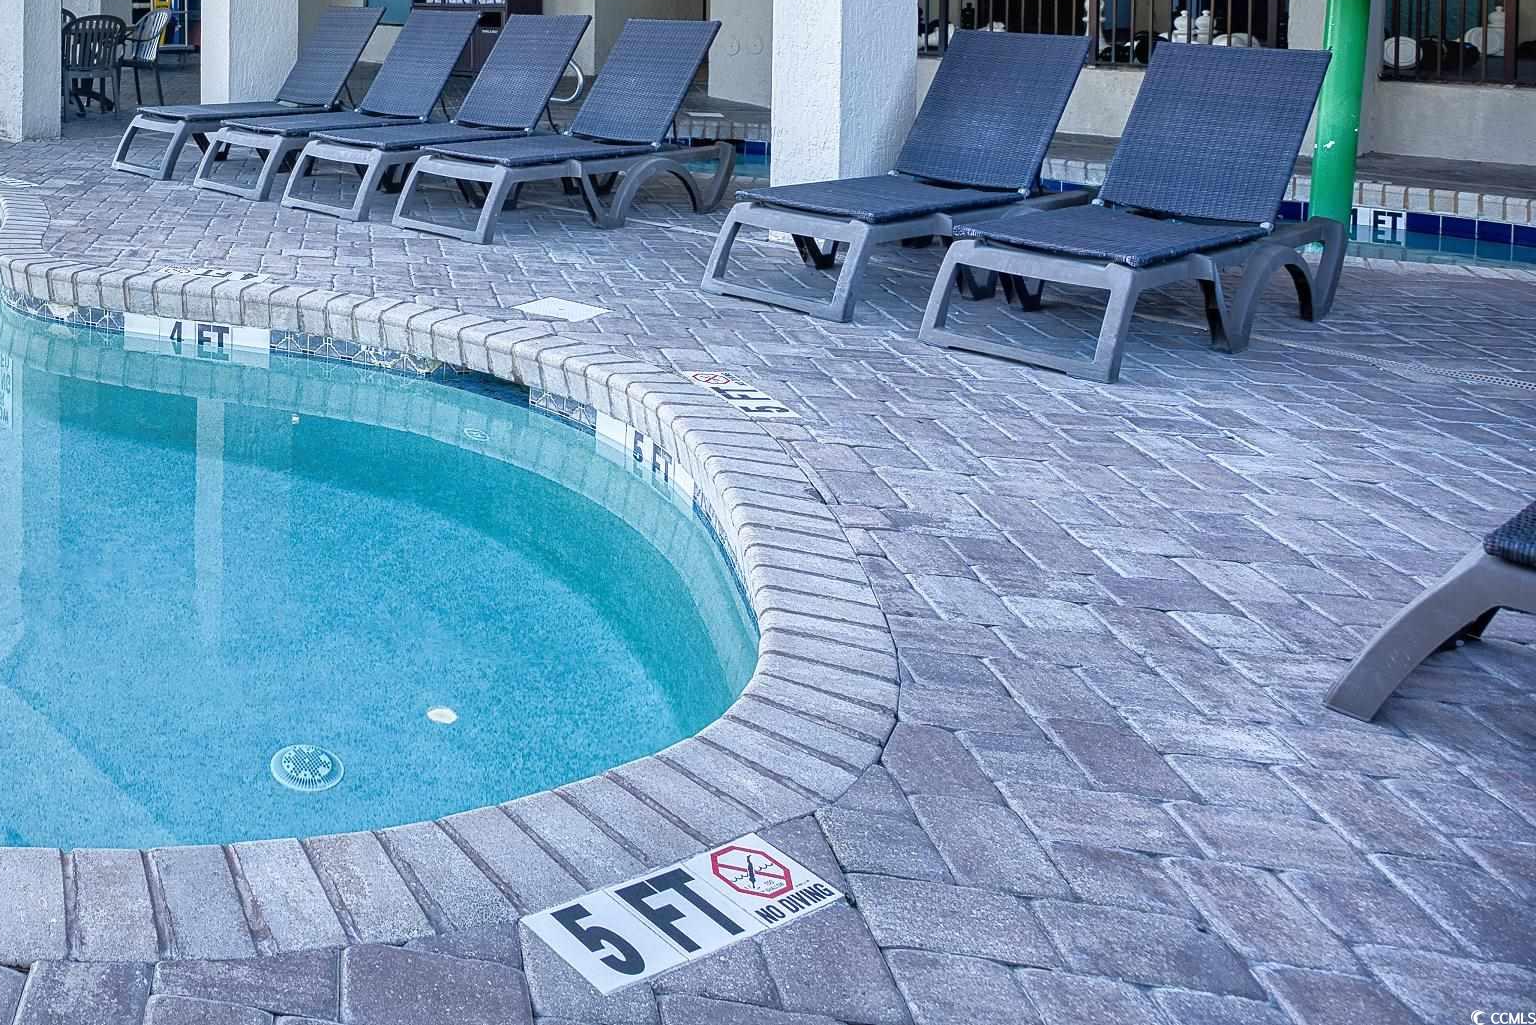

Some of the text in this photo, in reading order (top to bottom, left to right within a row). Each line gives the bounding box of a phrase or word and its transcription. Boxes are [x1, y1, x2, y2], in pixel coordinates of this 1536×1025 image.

[169, 321, 230, 347] 4 FT
[711, 386, 772, 401] FT
[633, 430, 673, 483] 5 FT
[550, 868, 745, 975] 5 FT
[754, 903, 786, 924] NO
[781, 883, 835, 916] DIVING
